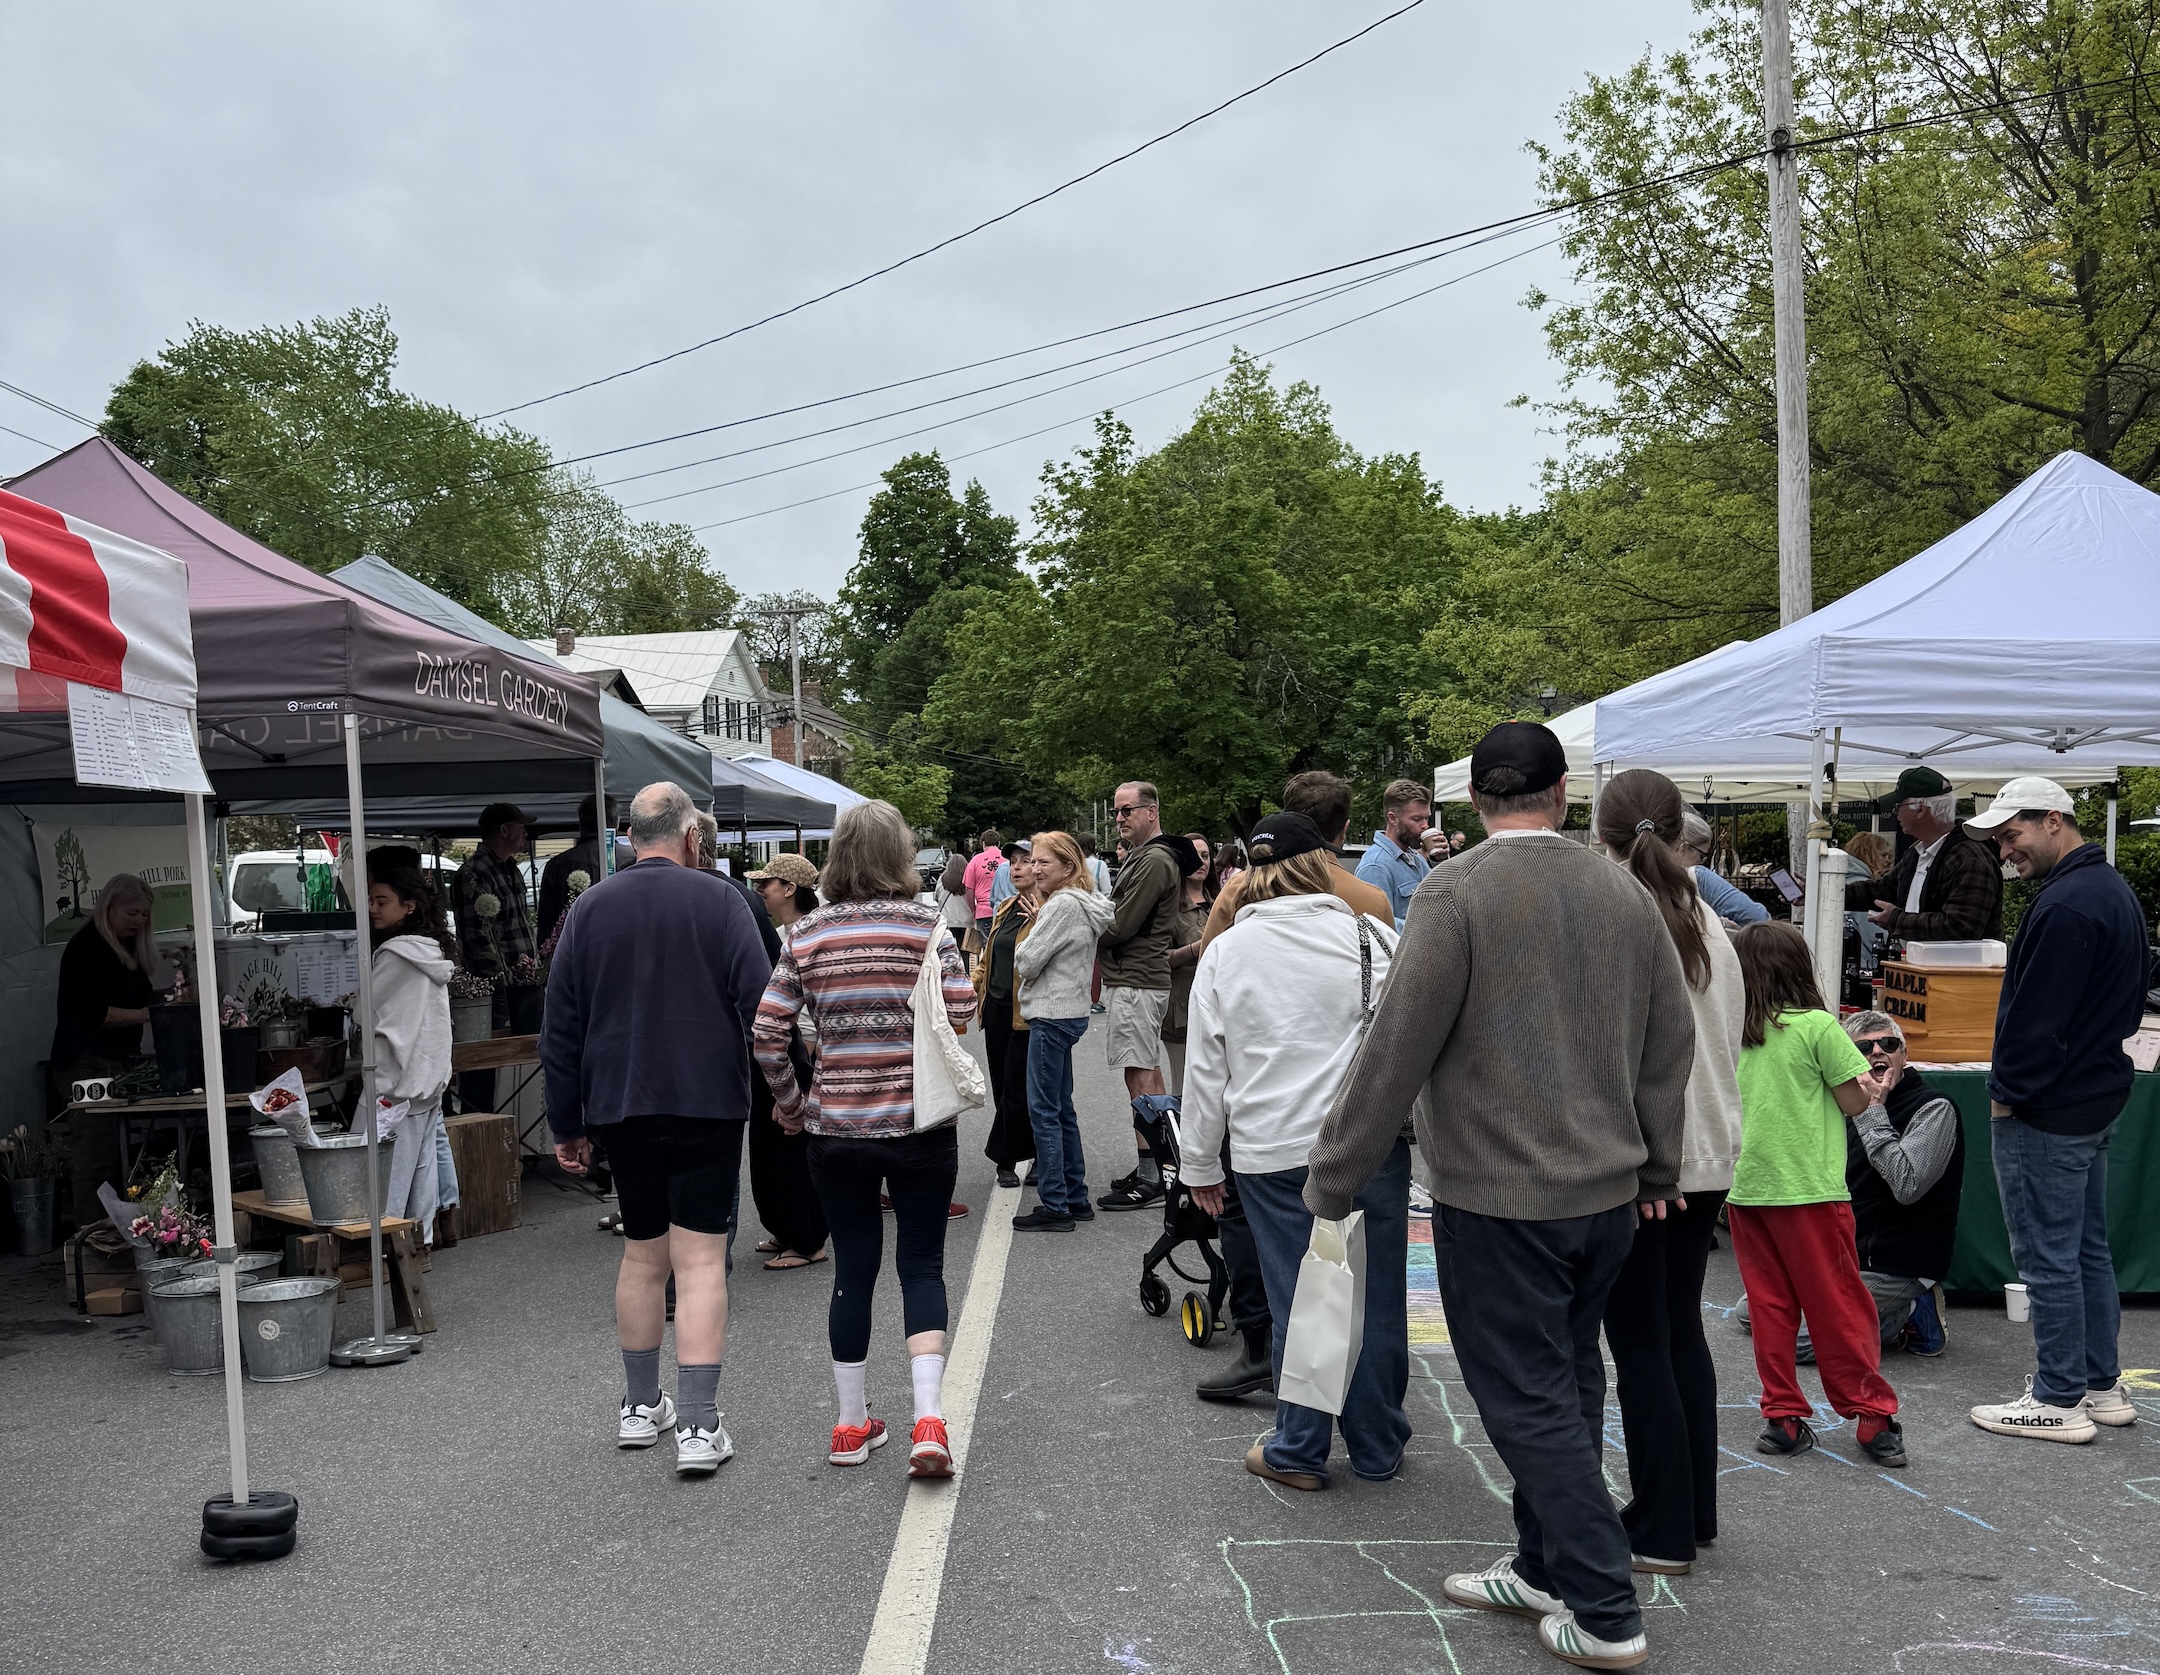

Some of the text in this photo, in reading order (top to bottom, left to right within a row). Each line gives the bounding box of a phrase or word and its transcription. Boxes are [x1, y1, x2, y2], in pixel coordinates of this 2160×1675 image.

[415, 651, 569, 731] DAMSEL GARDEN
[299, 701, 339, 710] TentCraft
[1878, 812, 1892, 820] HOP
[163, 865, 187, 882] PORK
[1885, 970, 1927, 996] MAPLE
[1884, 996, 1927, 1022] CREAM
[2001, 1415, 2064, 1427] adidas
